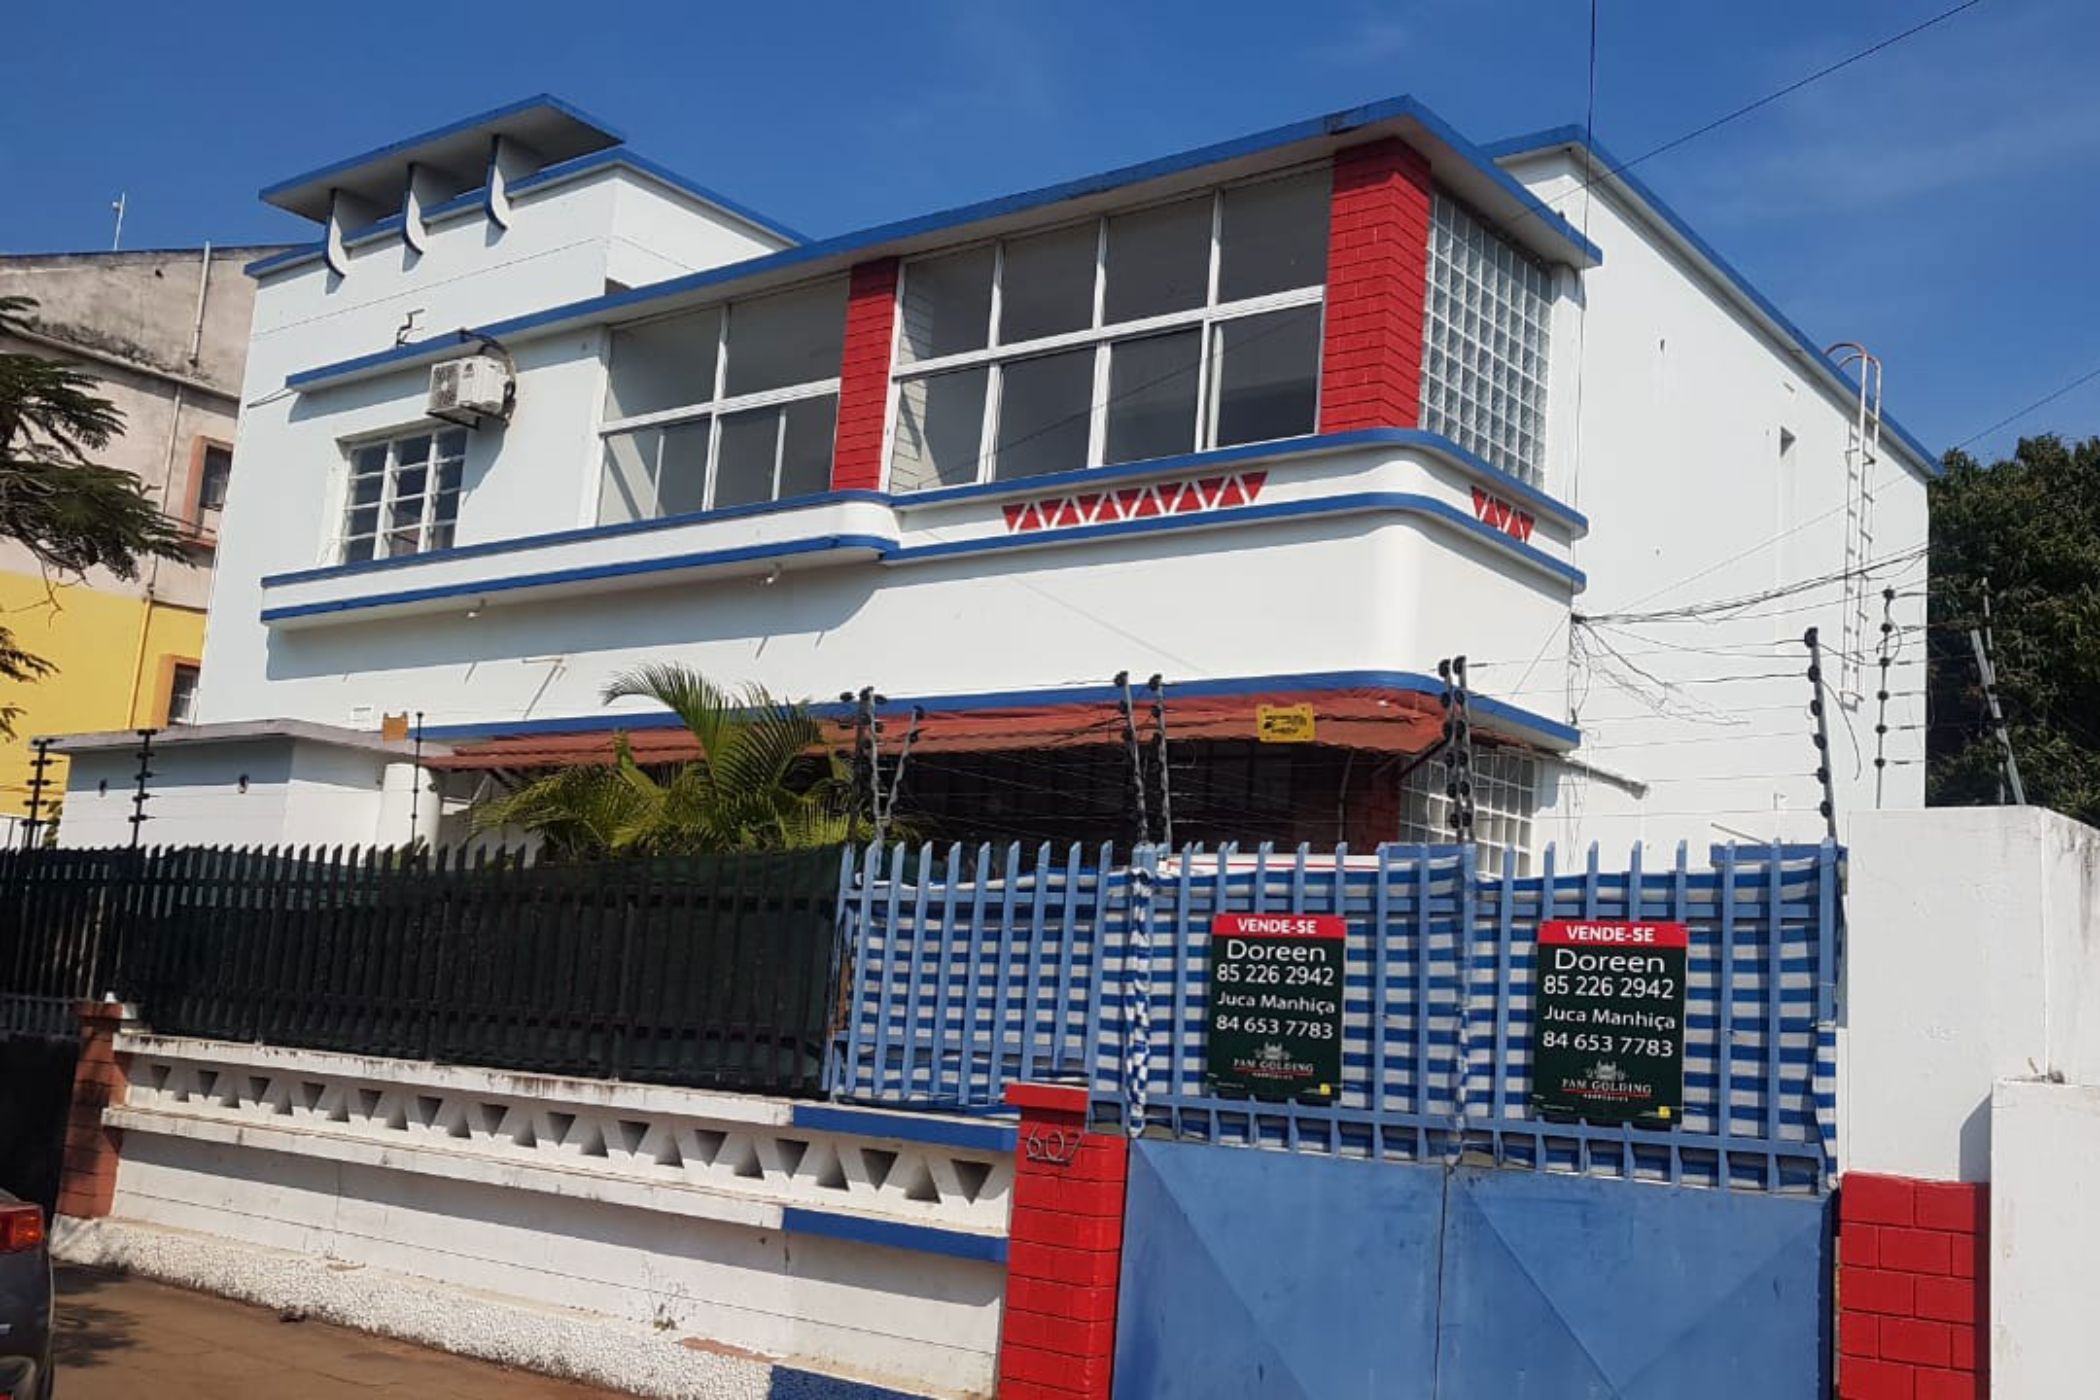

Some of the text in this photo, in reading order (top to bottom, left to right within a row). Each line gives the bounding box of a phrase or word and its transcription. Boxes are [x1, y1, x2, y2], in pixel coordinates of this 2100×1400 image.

[1237, 918, 1317, 934] VENDE-SE
[1566, 925, 1655, 942] VENDE-SE
[1227, 939, 1326, 962] Doreen
[1555, 949, 1665, 973] Doreen
[1217, 964, 1334, 986] 85 226 2942
[1544, 975, 1674, 999] 85 226 2942
[1217, 991, 1336, 1015] Juca Manhiça
[1216, 1015, 1333, 1039] 84 653 7783
[1543, 1004, 1676, 1032] Juca Manhiça
[1542, 1031, 1673, 1058] 84 653 7783
[1592, 1080, 1652, 1094] GOLDING
[1026, 1123, 1083, 1162] 607
